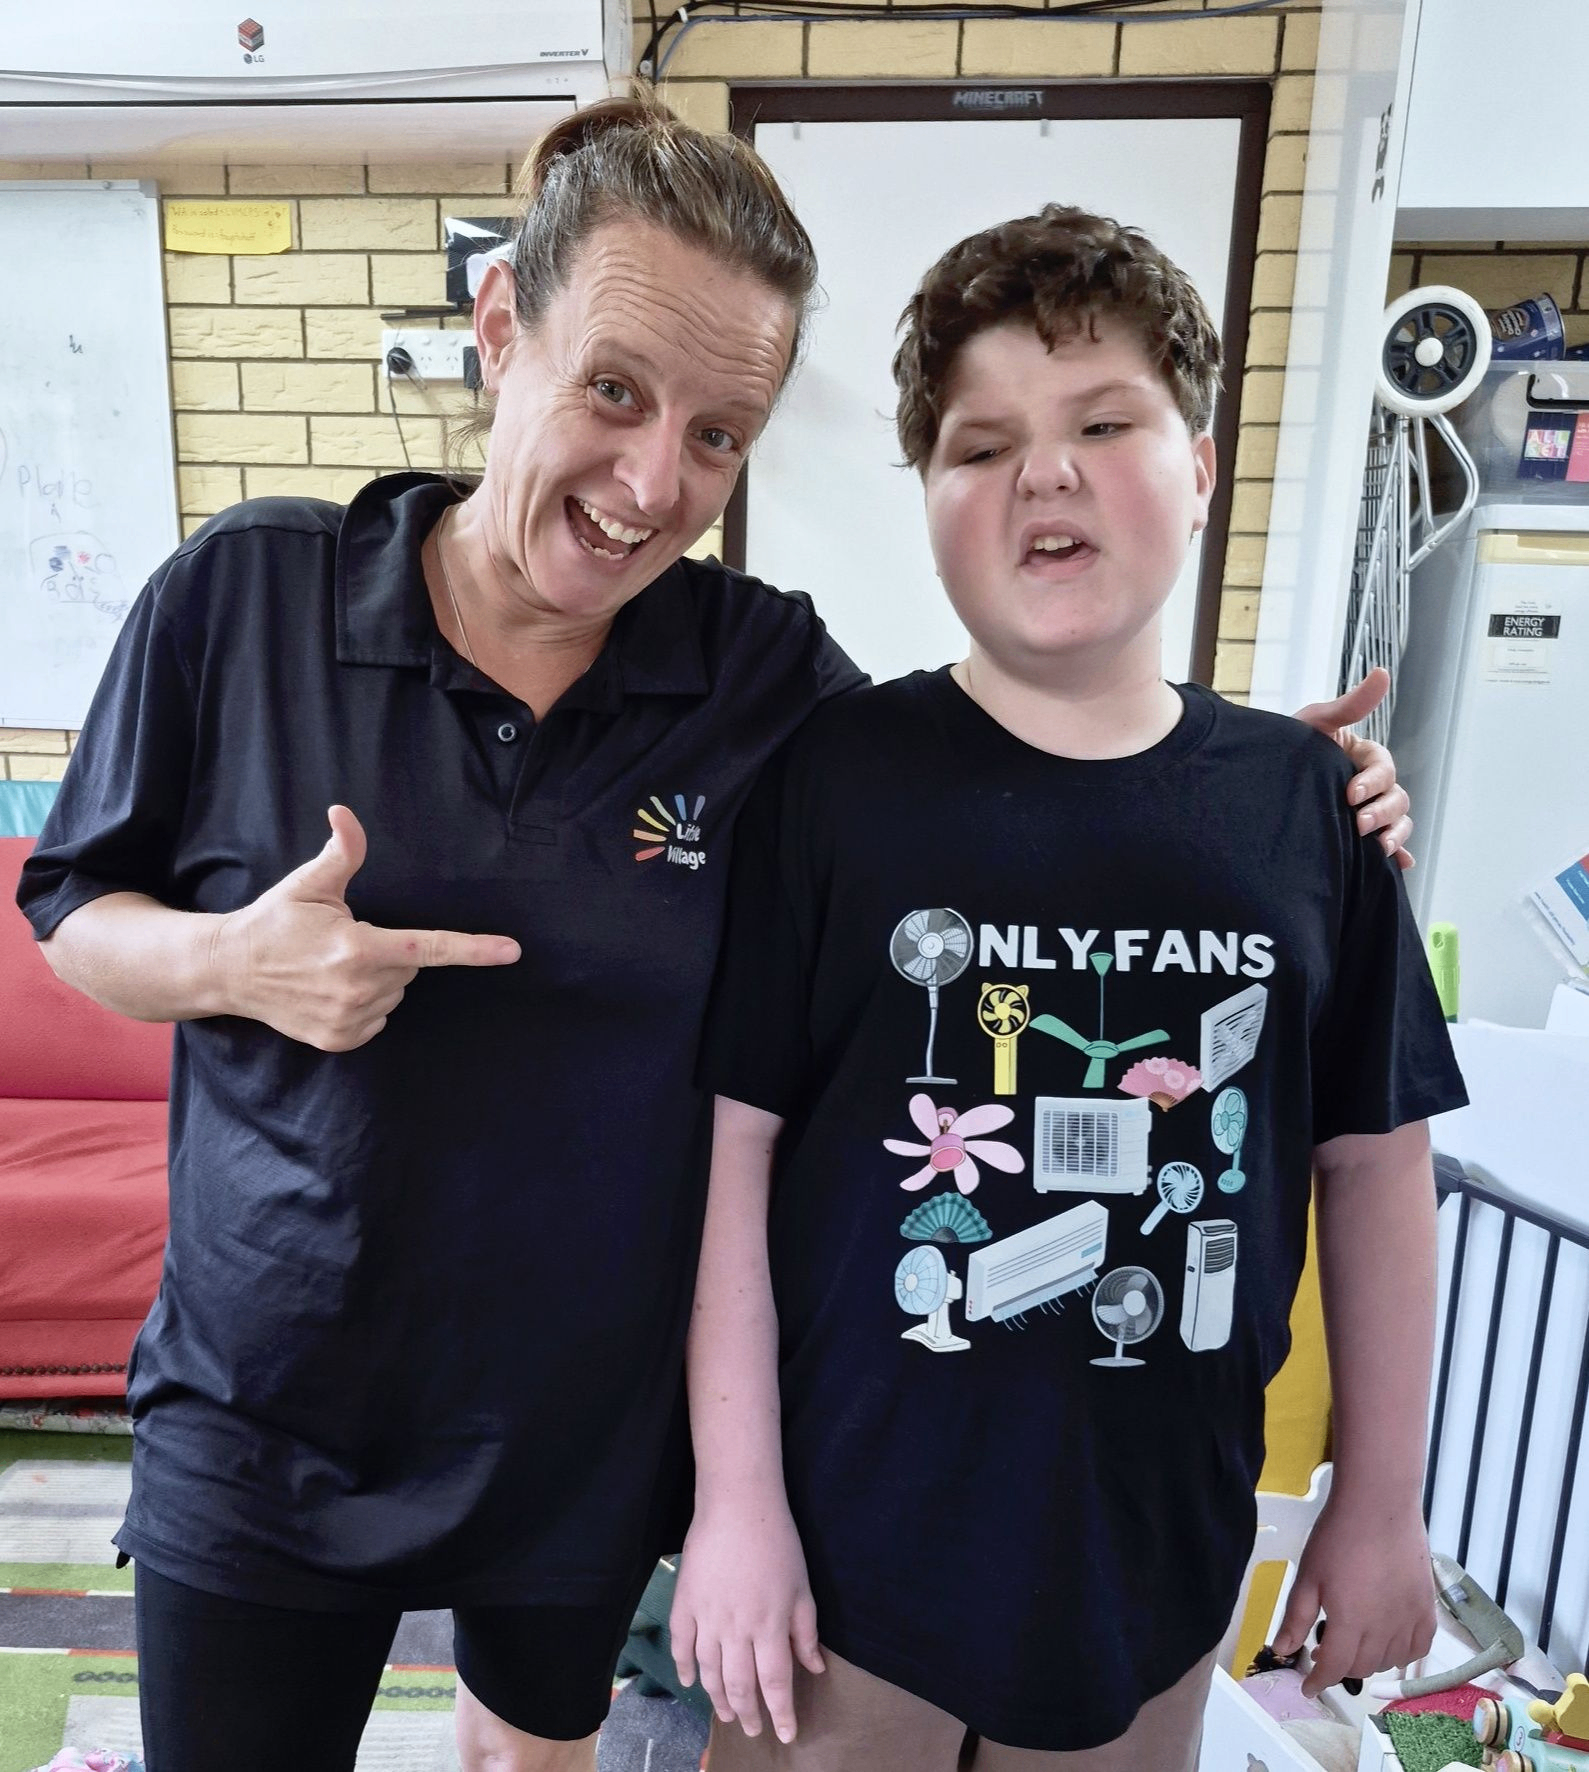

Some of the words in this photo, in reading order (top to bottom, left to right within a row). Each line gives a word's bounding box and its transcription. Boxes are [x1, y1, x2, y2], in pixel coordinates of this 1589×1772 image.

[580, 48, 590, 57] V
[952, 90, 1044, 107] MINECRAFT
[1503, 616, 1546, 628] ENERGY
[1502, 626, 1544, 637] RATING
[667, 845, 706, 870] Village
[1113, 929, 1276, 979] FANS
